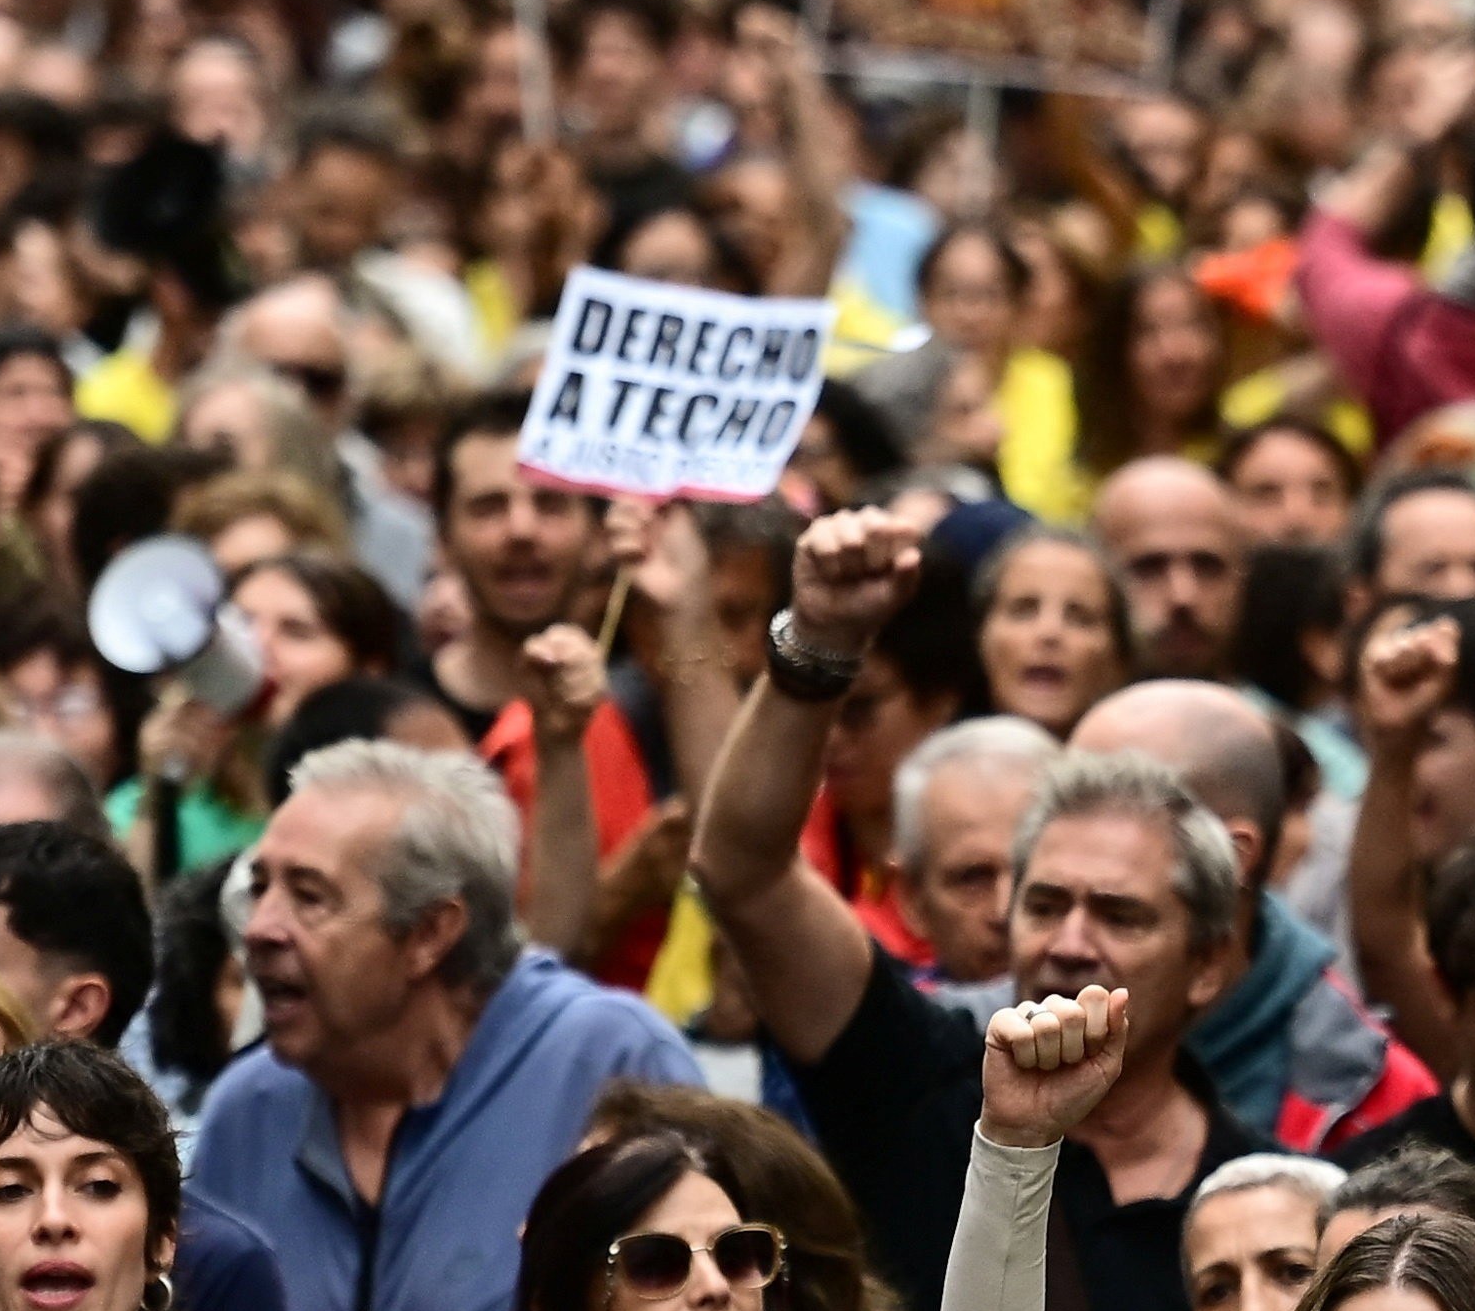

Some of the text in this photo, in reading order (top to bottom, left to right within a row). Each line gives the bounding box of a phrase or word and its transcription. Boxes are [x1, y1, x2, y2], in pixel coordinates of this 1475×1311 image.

[570, 298, 819, 383] DERECHO
[547, 369, 798, 454] A TECHO
